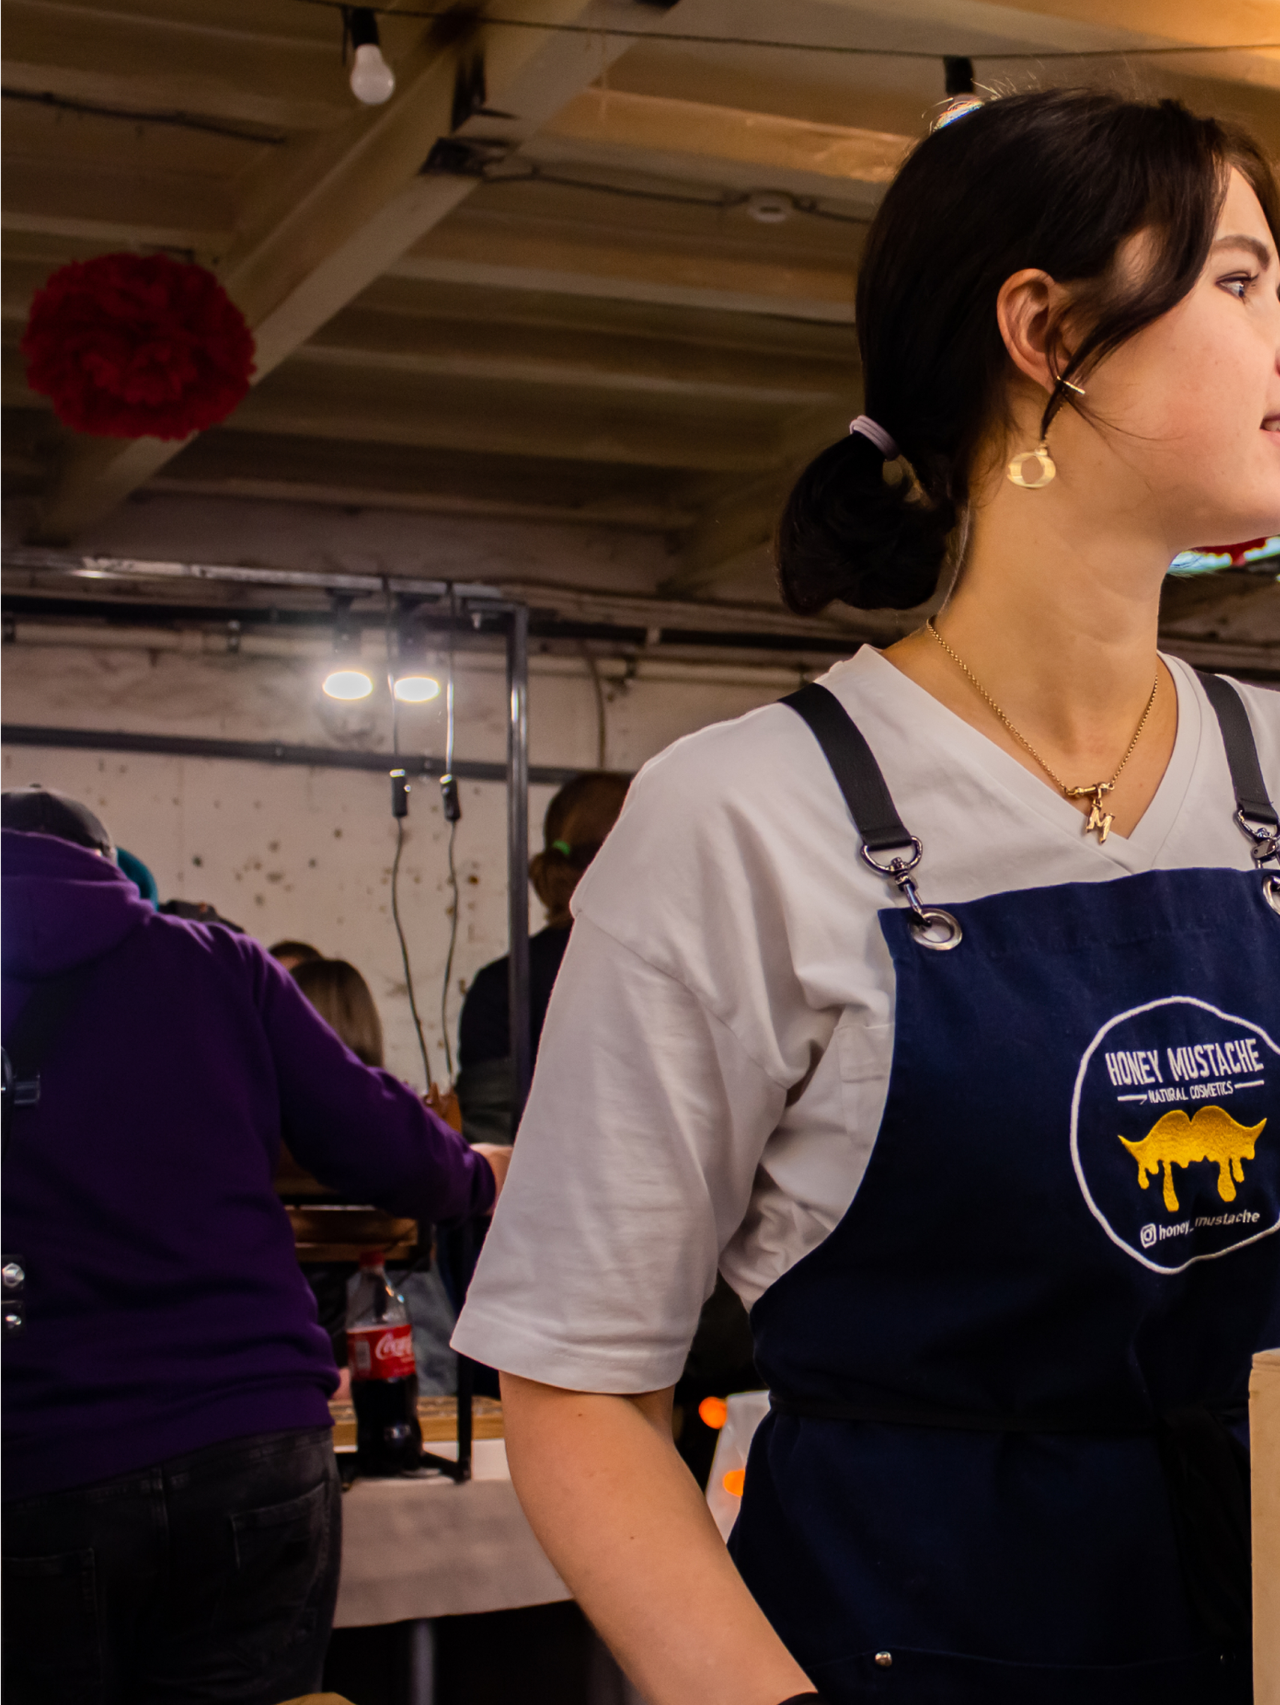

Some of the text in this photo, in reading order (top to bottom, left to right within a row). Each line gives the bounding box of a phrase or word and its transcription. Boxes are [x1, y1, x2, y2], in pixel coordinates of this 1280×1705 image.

[1105, 1038, 1264, 1086] HONEY MUSTACHE
[1148, 1081, 1233, 1103] NATURAL COSMETICS
